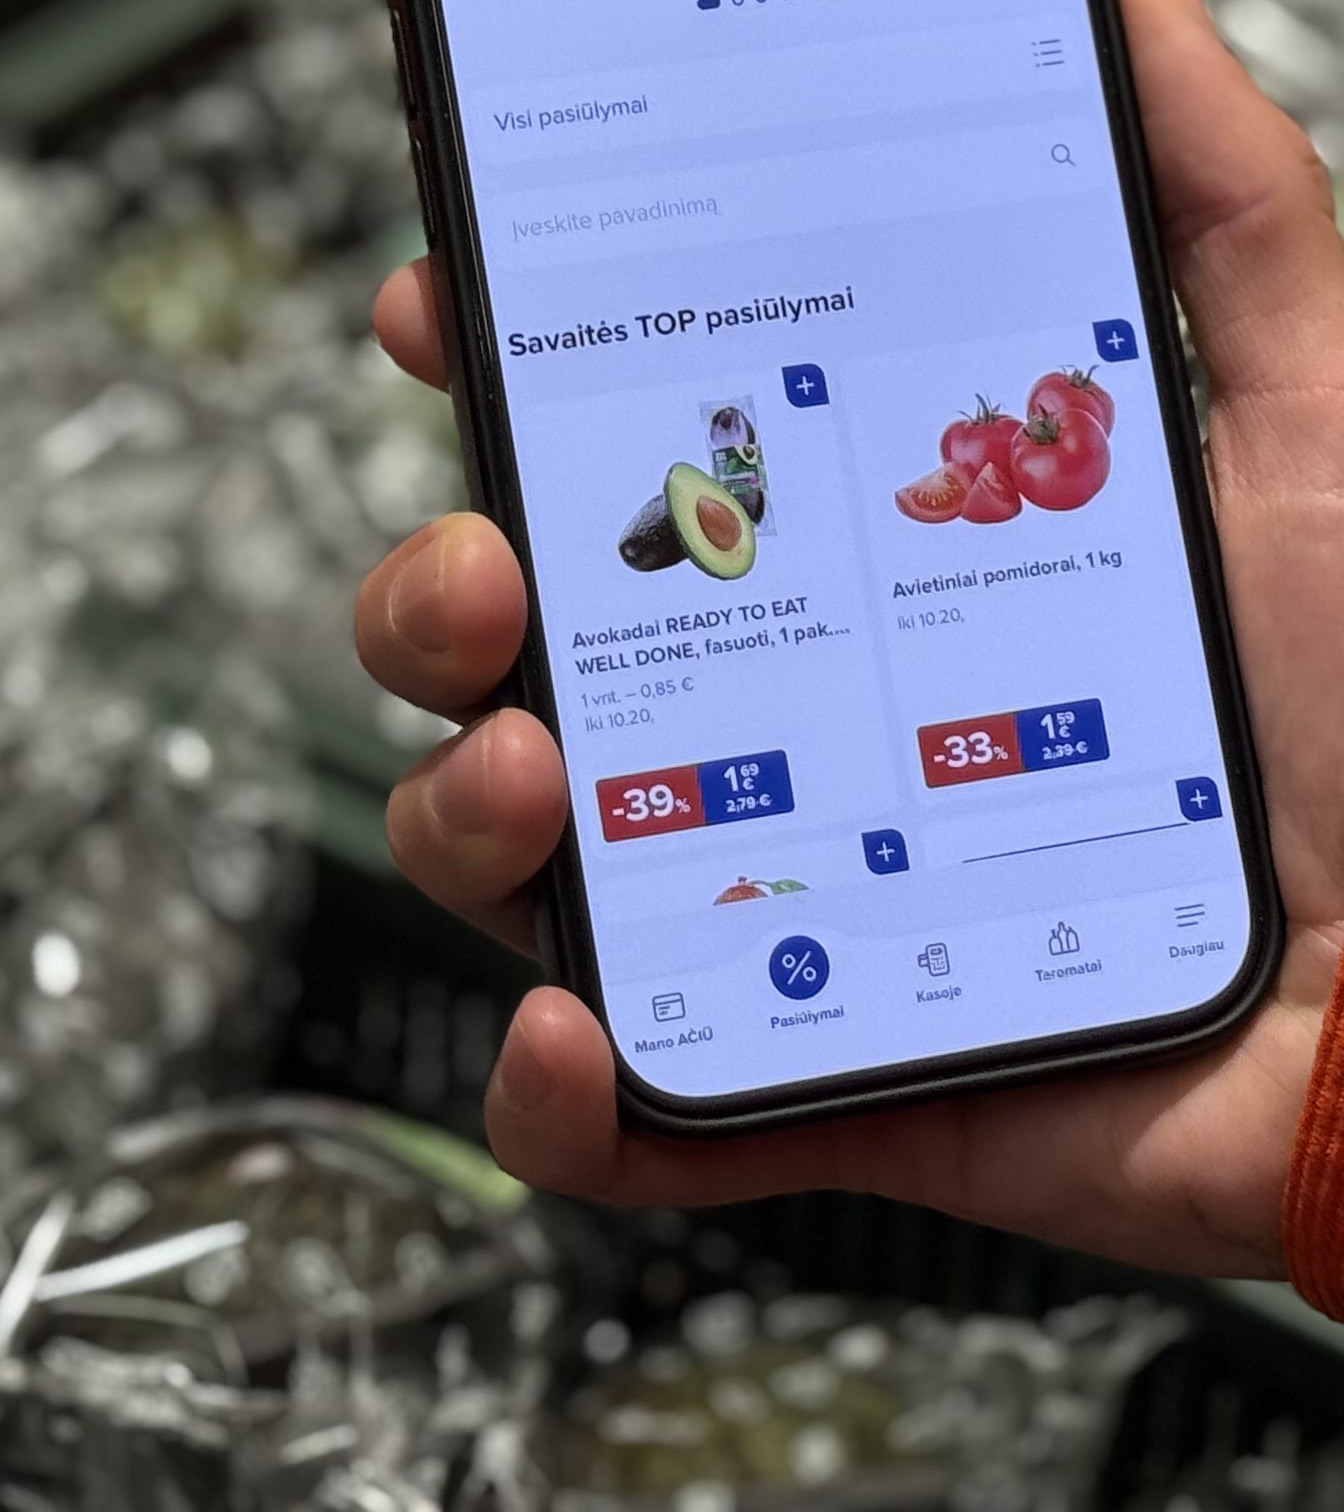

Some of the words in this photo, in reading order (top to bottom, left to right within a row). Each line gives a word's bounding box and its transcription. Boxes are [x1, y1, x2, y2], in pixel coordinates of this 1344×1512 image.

[492, 109, 533, 132] Visi
[538, 94, 649, 131] pasiūlymai
[511, 212, 593, 244] Įveskite
[598, 196, 720, 231] pavadinimą
[507, 319, 629, 357] Savaitės
[635, 309, 697, 339] TOP
[705, 285, 856, 335] pasiūlymai
[892, 569, 978, 599] Avietiniai
[982, 555, 1082, 588] pomidorai,
[1085, 551, 1096, 569] 1
[1098, 550, 1124, 569] kg
[571, 619, 662, 649] Avokadai
[665, 608, 734, 635] READY
[737, 603, 767, 623] TO
[770, 596, 809, 618] EAT
[897, 614, 916, 630] Iki
[574, 652, 631, 676] WELL
[634, 641, 702, 666] DONE,
[704, 628, 776, 657] fasuoti,
[778, 626, 789, 643] 1
[580, 692, 589, 709] 1
[590, 689, 623, 706] vnt.
[639, 678, 677, 700] 0,85
[680, 676, 695, 692] €
[584, 714, 605, 733] Iki
[933, 731, 1009, 769] -33%
[612, 783, 692, 822] -39%
[1168, 939, 1226, 960] Daugiau
[1034, 958, 1103, 983] Taromatai
[915, 985, 964, 1003] Kasoje
[769, 1004, 846, 1030] Pasiūlymai
[634, 1038, 675, 1054] Mano
[677, 1025, 715, 1047] AČIŪ
